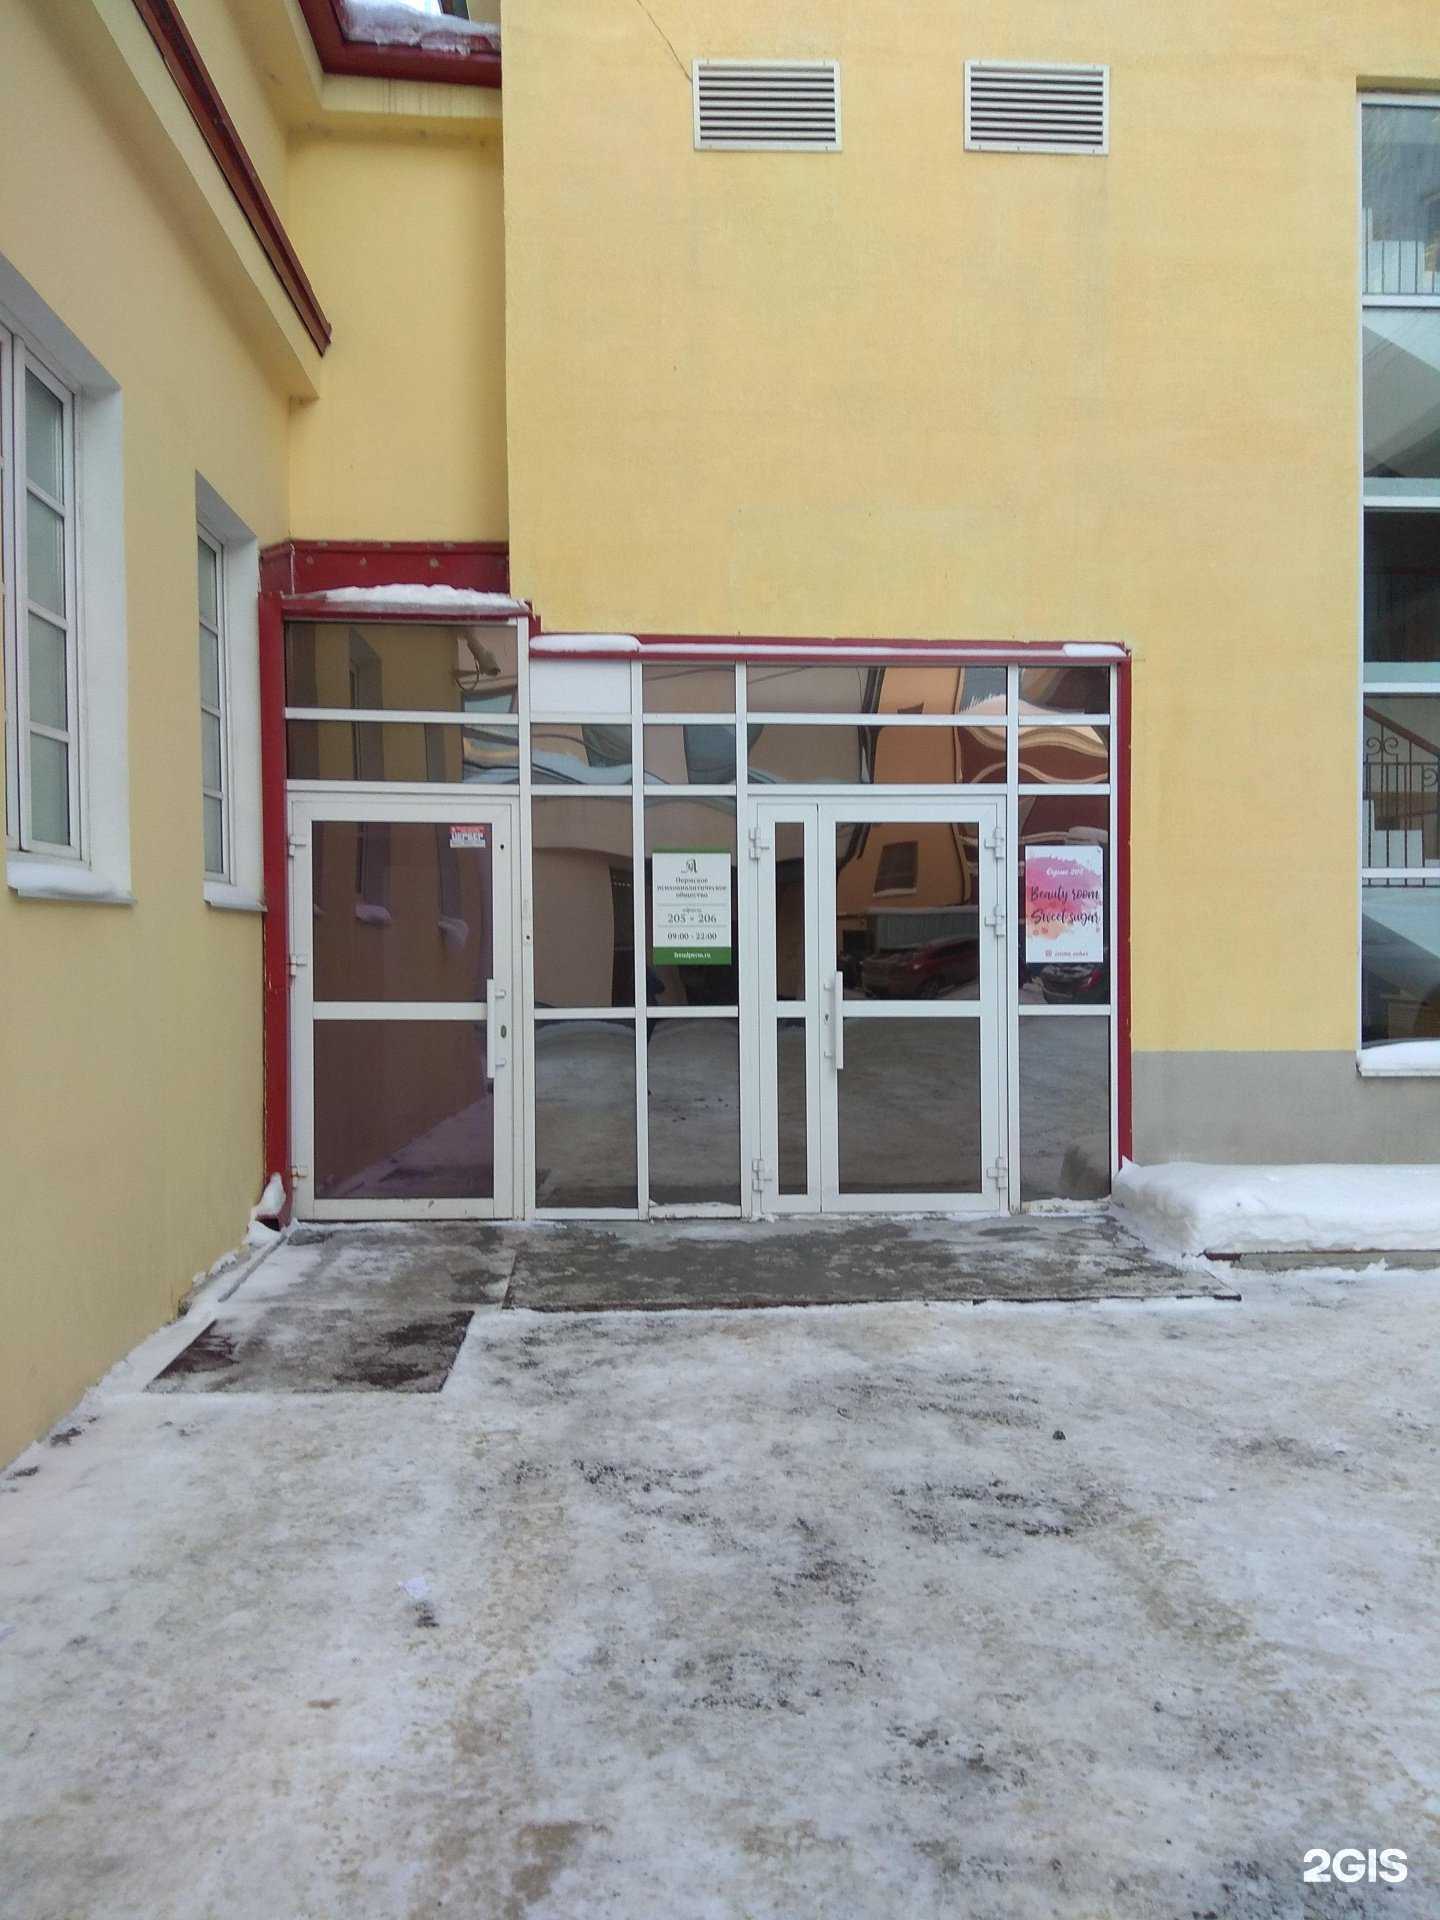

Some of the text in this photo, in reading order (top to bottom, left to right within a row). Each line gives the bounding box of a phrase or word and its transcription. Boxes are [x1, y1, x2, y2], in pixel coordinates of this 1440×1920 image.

[1031, 885, 1100, 903] Beauty room
[667, 913, 687, 923] 205
[698, 913, 717, 923] 206
[1031, 908, 1100, 926] Sweet sugar
[667, 931, 689, 940] 09:00
[696, 931, 717, 940] 22:00
